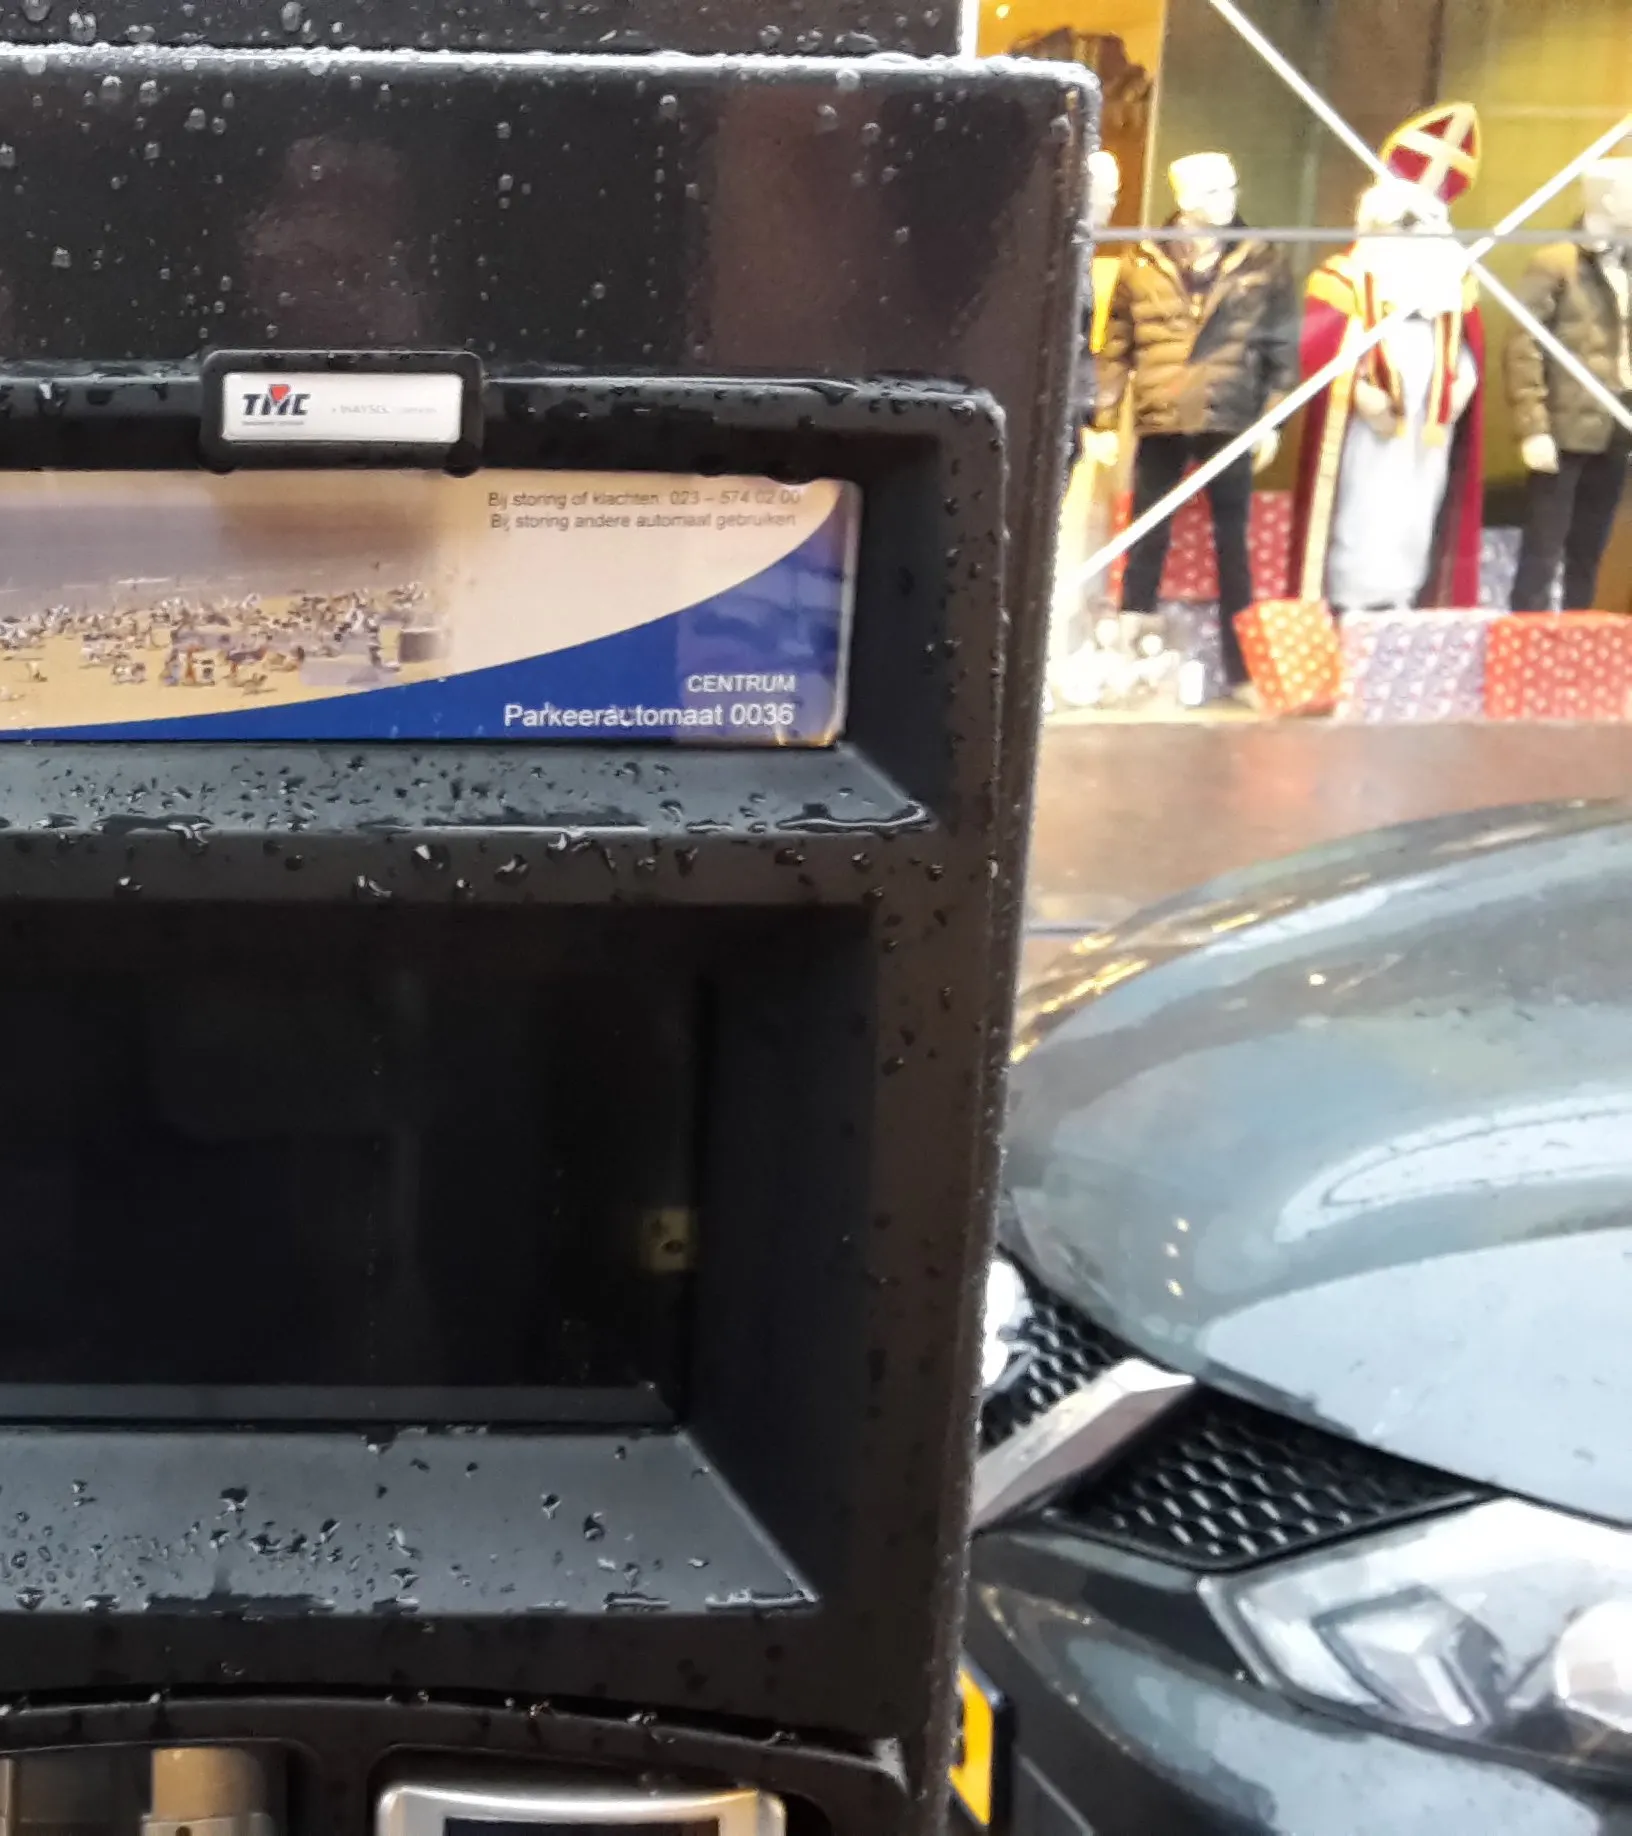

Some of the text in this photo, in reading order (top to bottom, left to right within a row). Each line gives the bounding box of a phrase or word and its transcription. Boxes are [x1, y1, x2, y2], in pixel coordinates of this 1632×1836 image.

[242, 392, 311, 416] TMC
[512, 492, 566, 509] storing
[571, 491, 588, 505] of
[670, 490, 699, 505] 023
[719, 490, 750, 504] 574
[779, 490, 801, 505] 00
[515, 514, 568, 531] storing
[575, 514, 630, 528] andere
[636, 513, 711, 528] automaat
[716, 514, 797, 530] gebruiken
[687, 674, 796, 693] CENTRUM
[504, 701, 795, 727] Parkeerautomaat 0036
